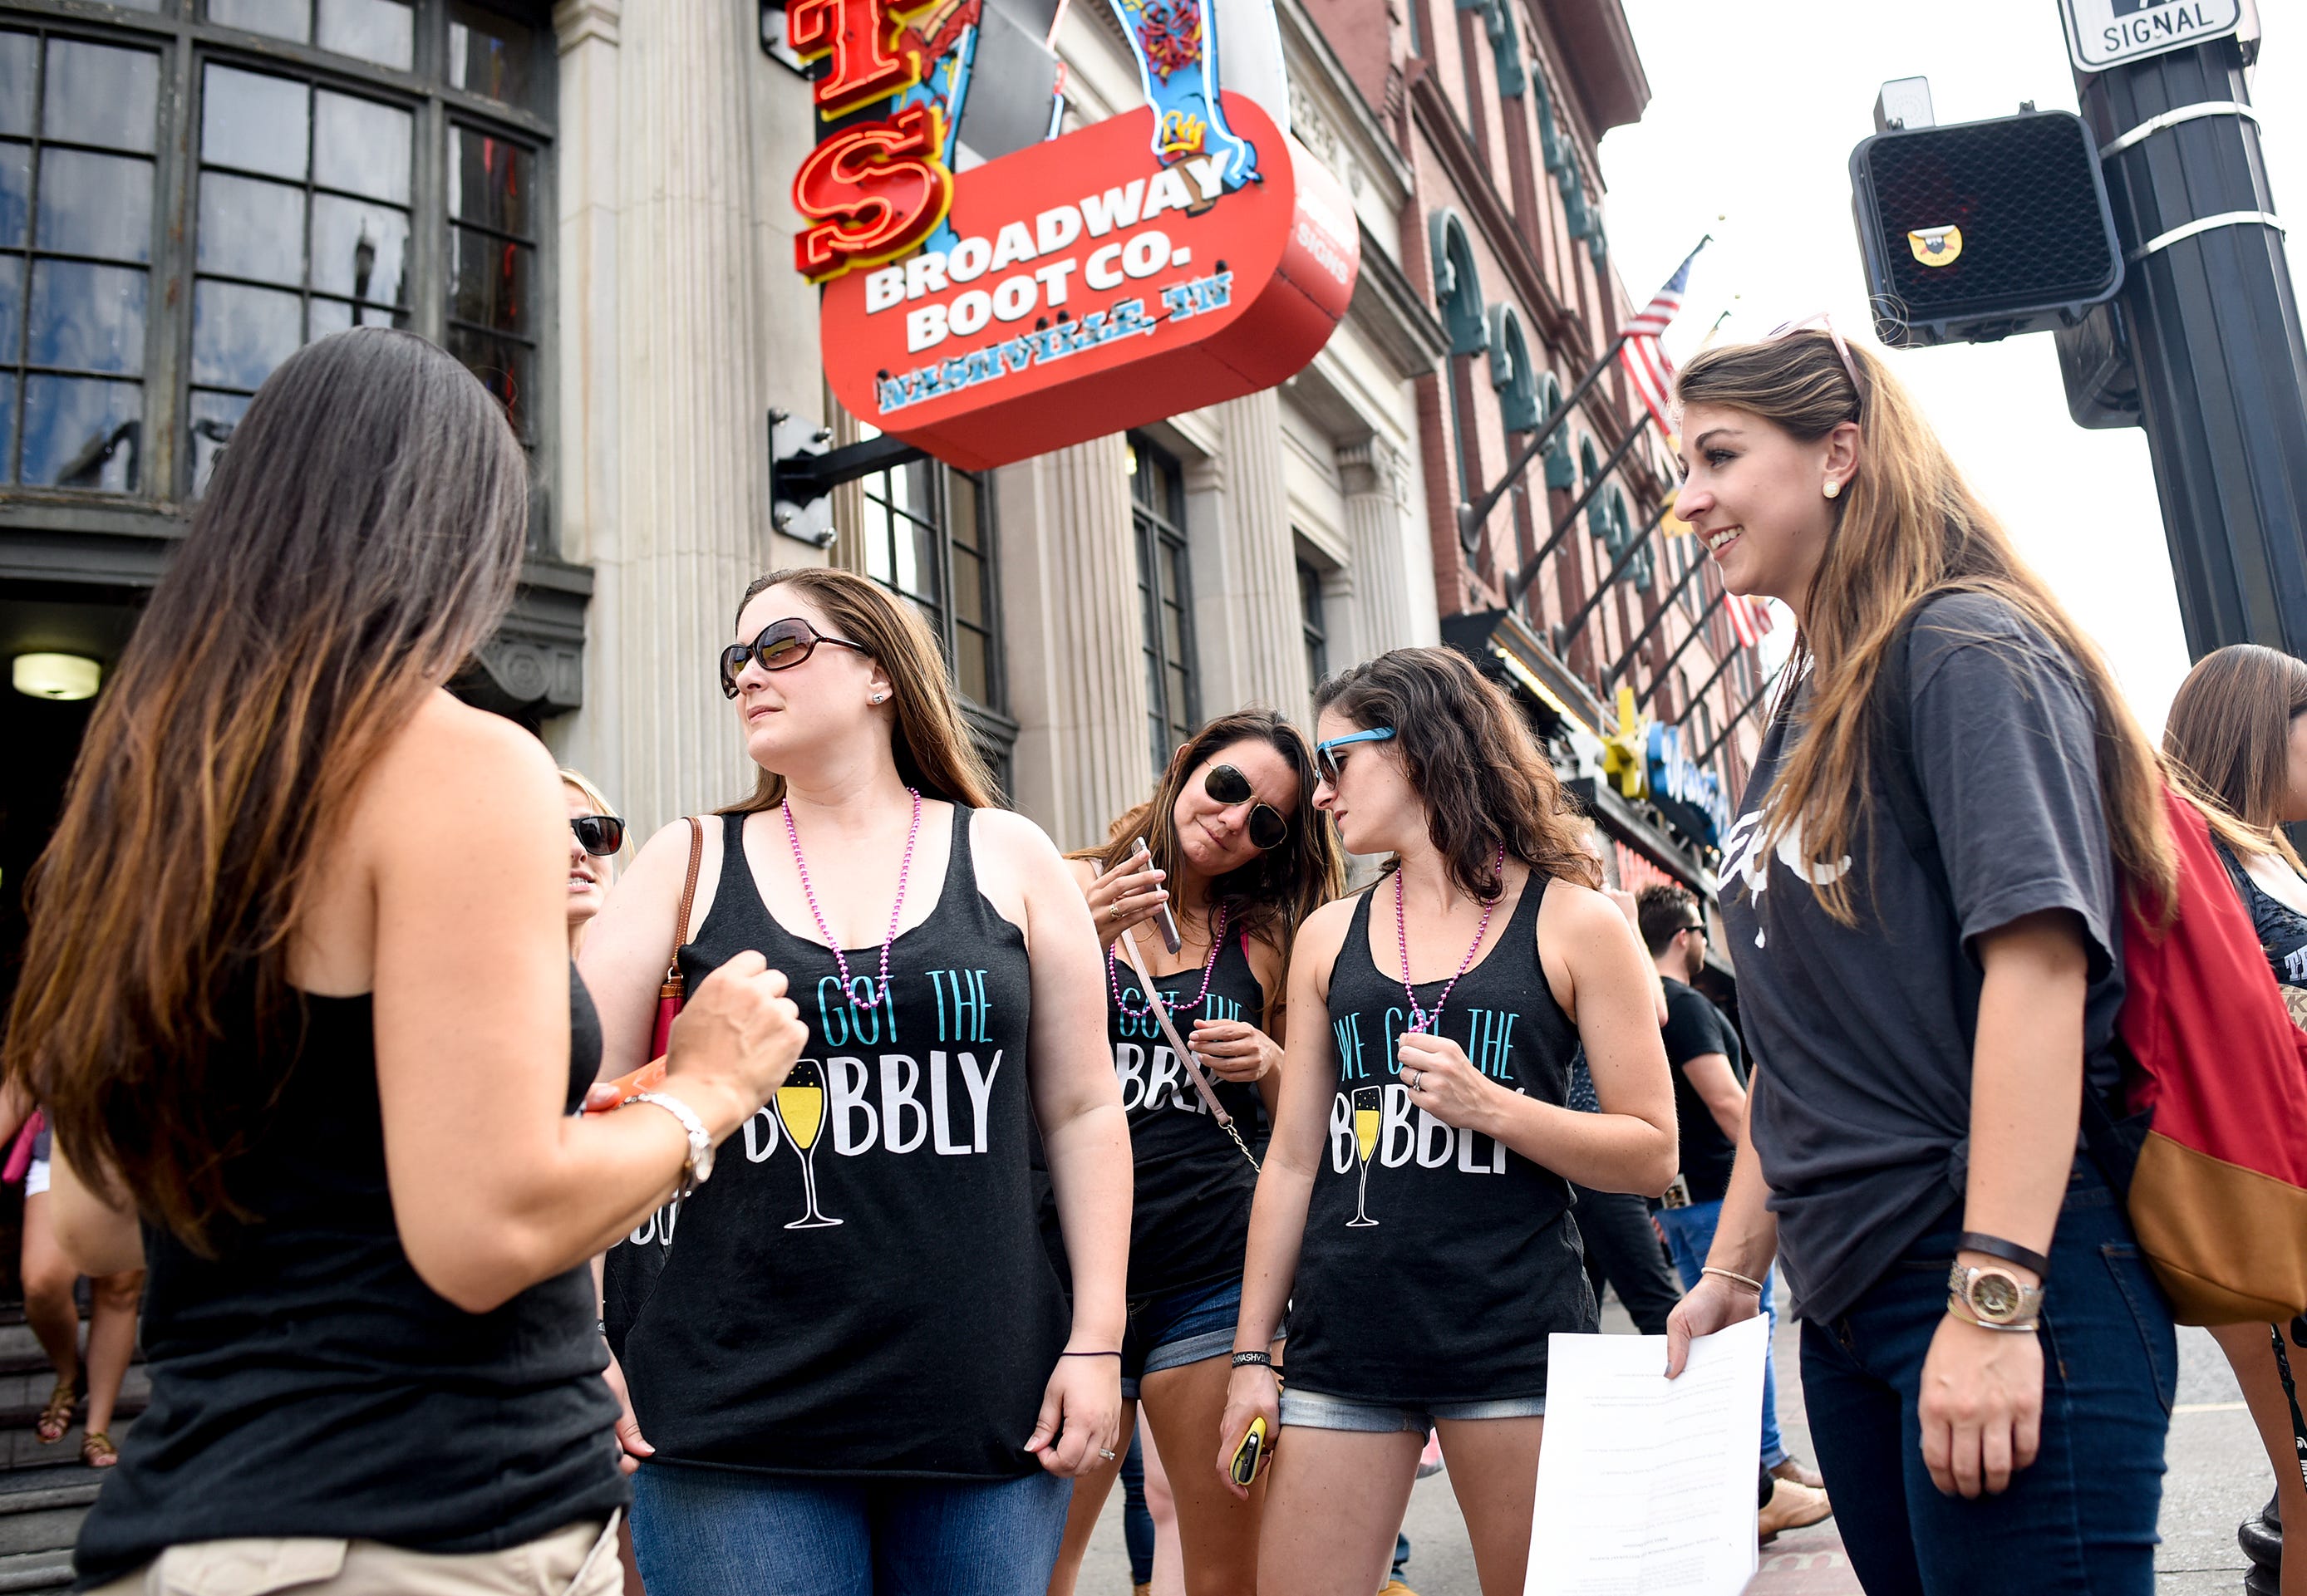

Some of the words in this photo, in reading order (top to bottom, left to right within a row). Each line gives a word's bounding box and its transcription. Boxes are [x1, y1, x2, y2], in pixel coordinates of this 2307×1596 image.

[2103, 2, 2215, 52] SIGNAL
[864, 150, 1232, 315] BROADWAY
[906, 258, 1077, 354] BOOT
[1084, 231, 1192, 291] CO.
[1161, 271, 1233, 322] TN
[817, 974, 898, 1047] GOT
[924, 968, 994, 1044] THE
[1333, 1012, 1371, 1082] WE
[1467, 1008, 1521, 1080] THE
